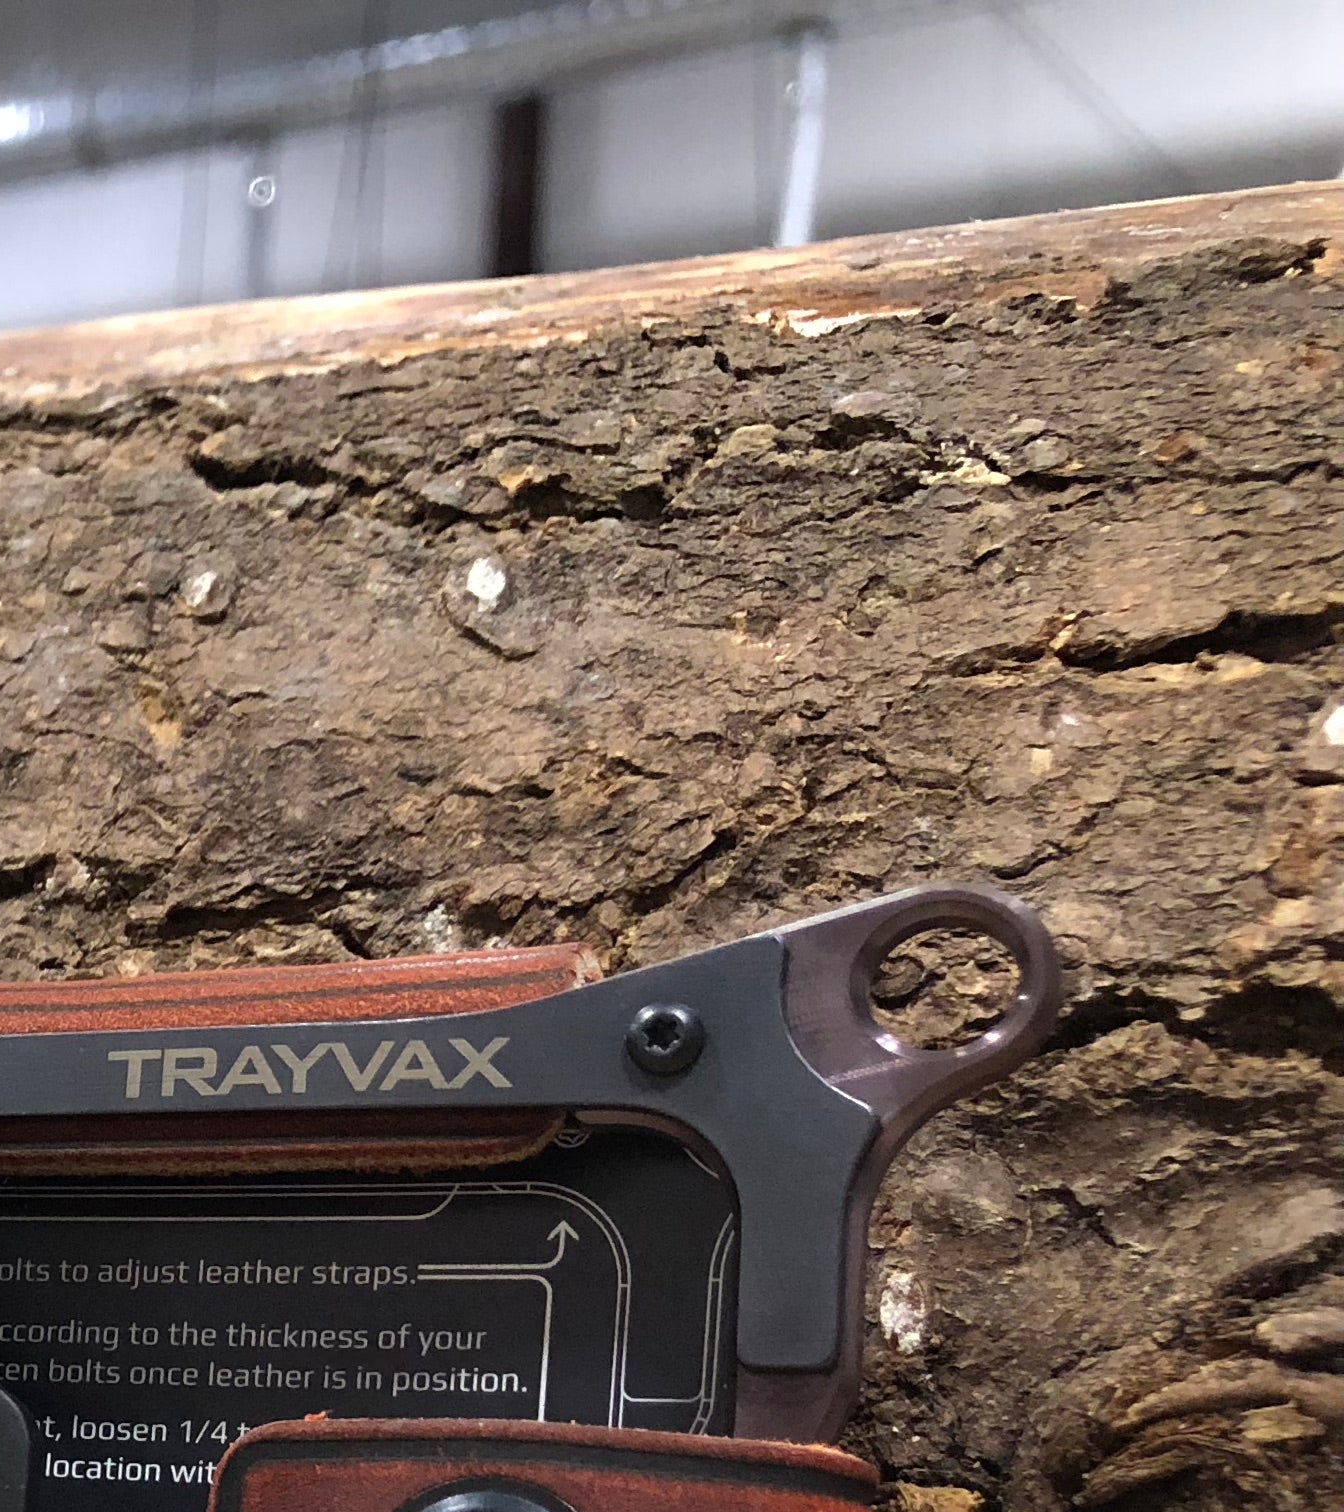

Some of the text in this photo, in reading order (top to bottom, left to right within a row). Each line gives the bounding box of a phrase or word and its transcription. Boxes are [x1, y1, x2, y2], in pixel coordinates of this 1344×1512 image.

[108, 1037, 513, 1099] TRAYVAX
[59, 1260, 89, 1284] to
[98, 1258, 190, 1291] adjust
[198, 1259, 303, 1286] leather
[312, 1261, 416, 1291] straps.
[129, 1322, 160, 1345] to
[168, 1321, 217, 1347] the
[226, 1322, 368, 1350] thickness
[378, 1323, 411, 1350] of
[418, 1330, 487, 1357] your
[49, 1358, 121, 1385] bolts
[129, 1366, 200, 1387] once
[209, 1361, 314, 1391] leather
[323, 1365, 347, 1391] is
[356, 1366, 383, 1392] in
[392, 1366, 528, 1397] position.
[72, 1414, 167, 1443] loosen
[179, 1420, 228, 1445] 1/4
[44, 1452, 218, 1485] location wit
